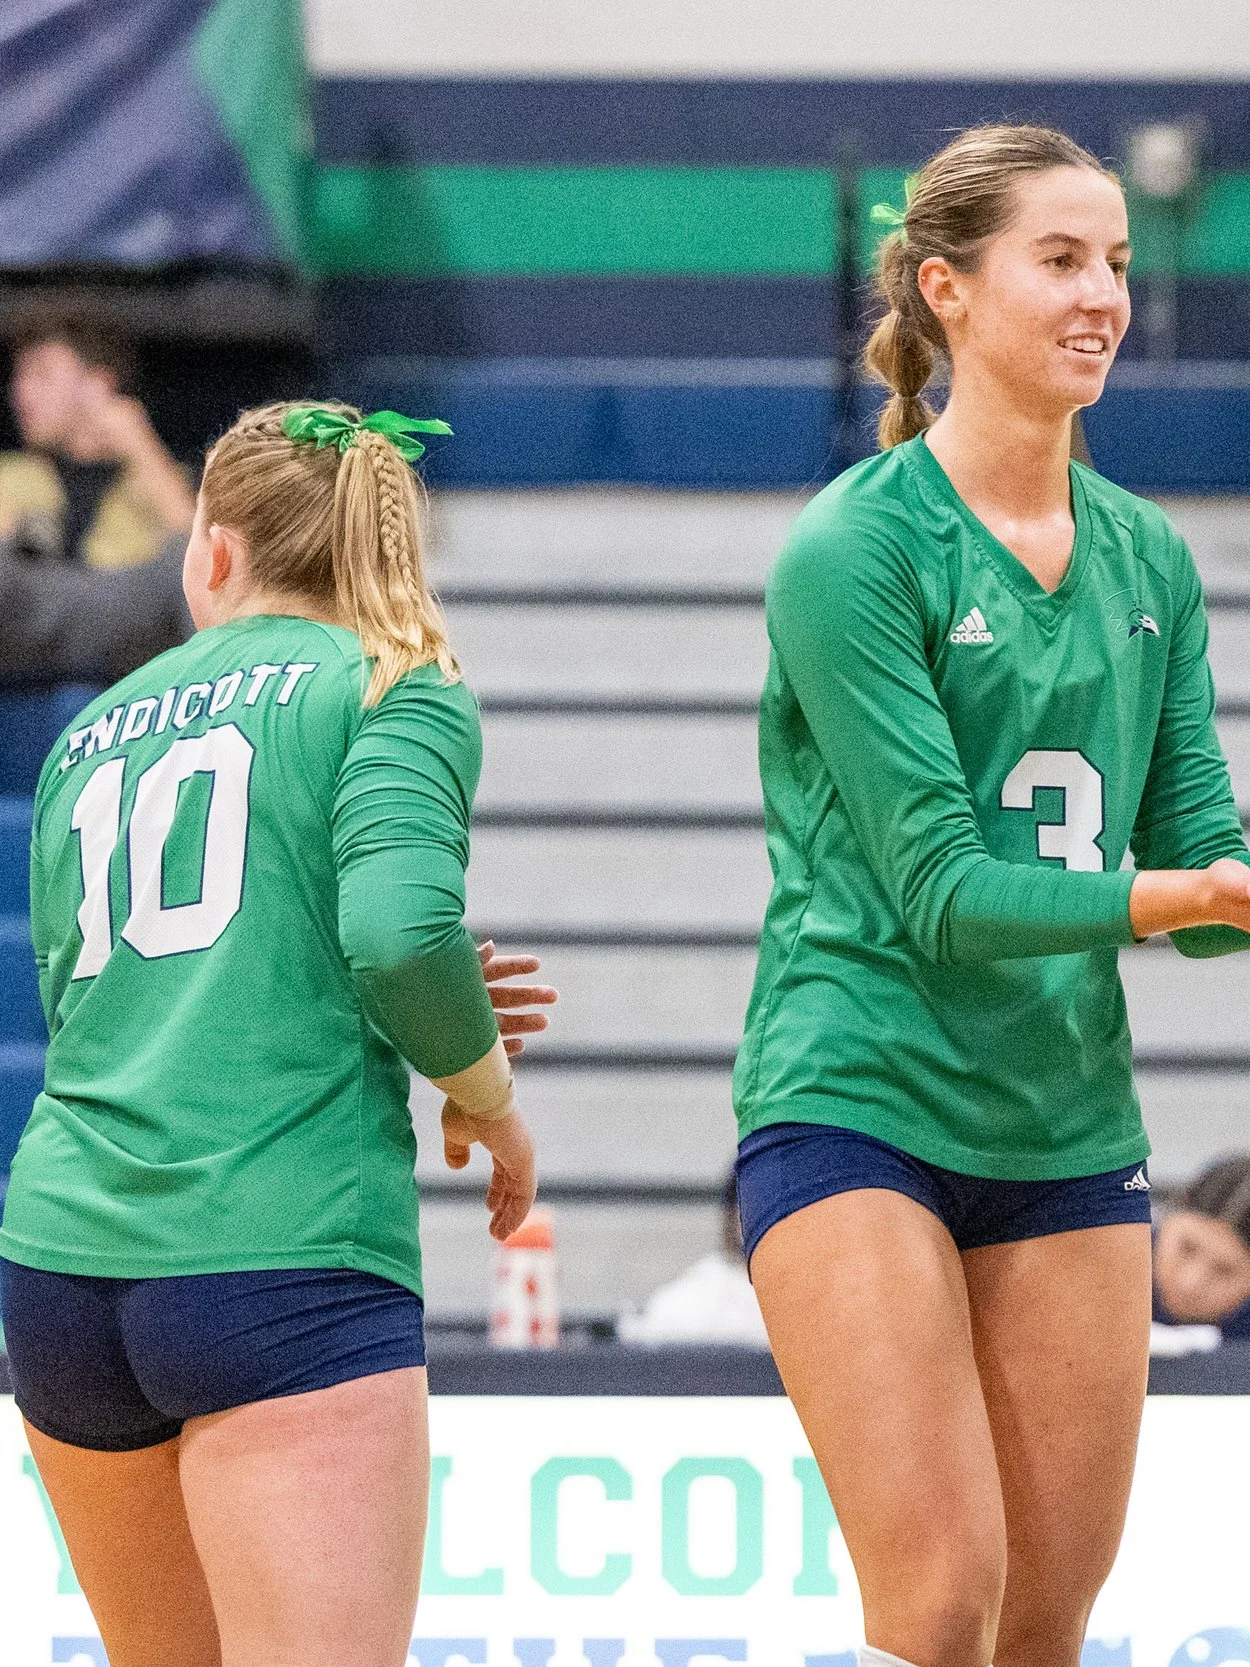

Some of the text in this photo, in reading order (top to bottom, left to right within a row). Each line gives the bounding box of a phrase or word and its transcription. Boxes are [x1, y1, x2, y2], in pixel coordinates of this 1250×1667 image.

[950, 630, 994, 643] adidas
[61, 662, 320, 771] ENDICOTT
[71, 723, 256, 982] 10
[1000, 747, 1106, 872] 3
